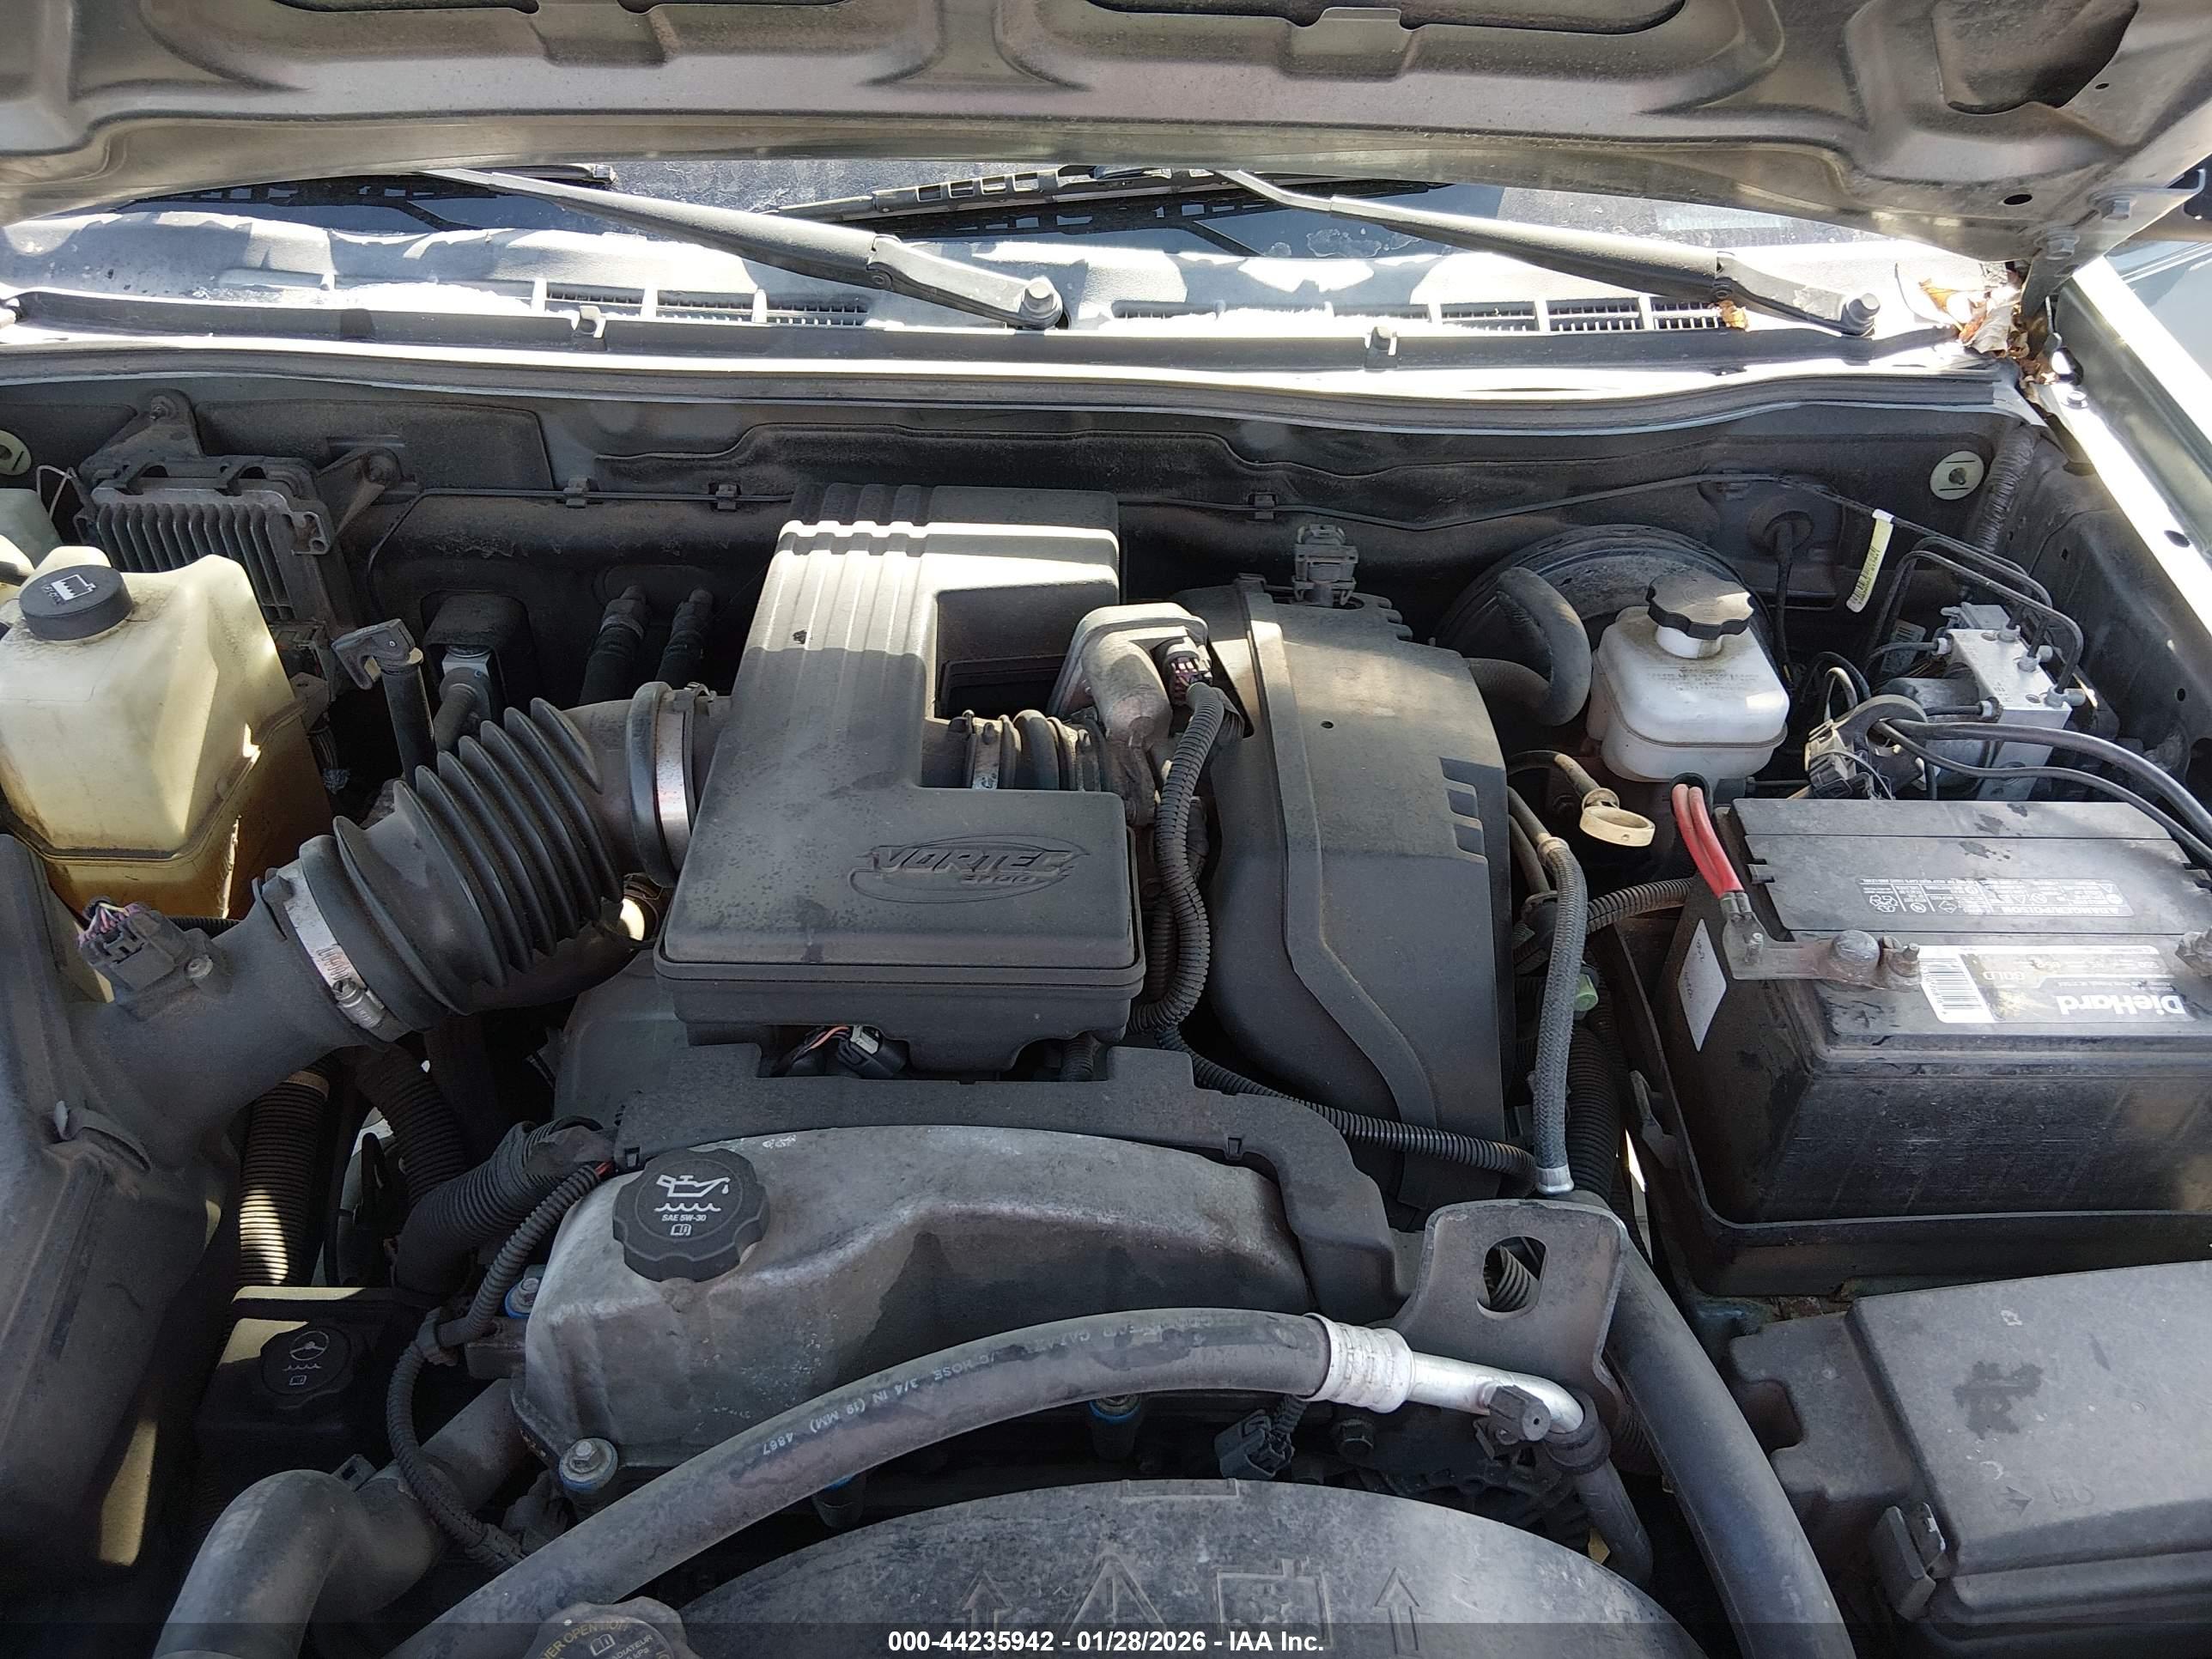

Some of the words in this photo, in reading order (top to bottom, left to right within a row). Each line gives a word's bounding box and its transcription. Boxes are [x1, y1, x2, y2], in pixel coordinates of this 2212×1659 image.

[1983, 971, 2026, 981] GOLD
[2056, 994, 2186, 1016] DieHard
[661, 1213, 678, 1222] SAE
[679, 1213, 708, 1222] 5W-30
[933, 1358, 972, 1381] HOSE
[872, 1388, 888, 1404] IN
[894, 1377, 918, 1396] 3/4
[847, 1398, 866, 1414] (19
[810, 1410, 840, 1433] MM)
[763, 1431, 794, 1455] 4867
[563, 1623, 598, 1644] OPEN
